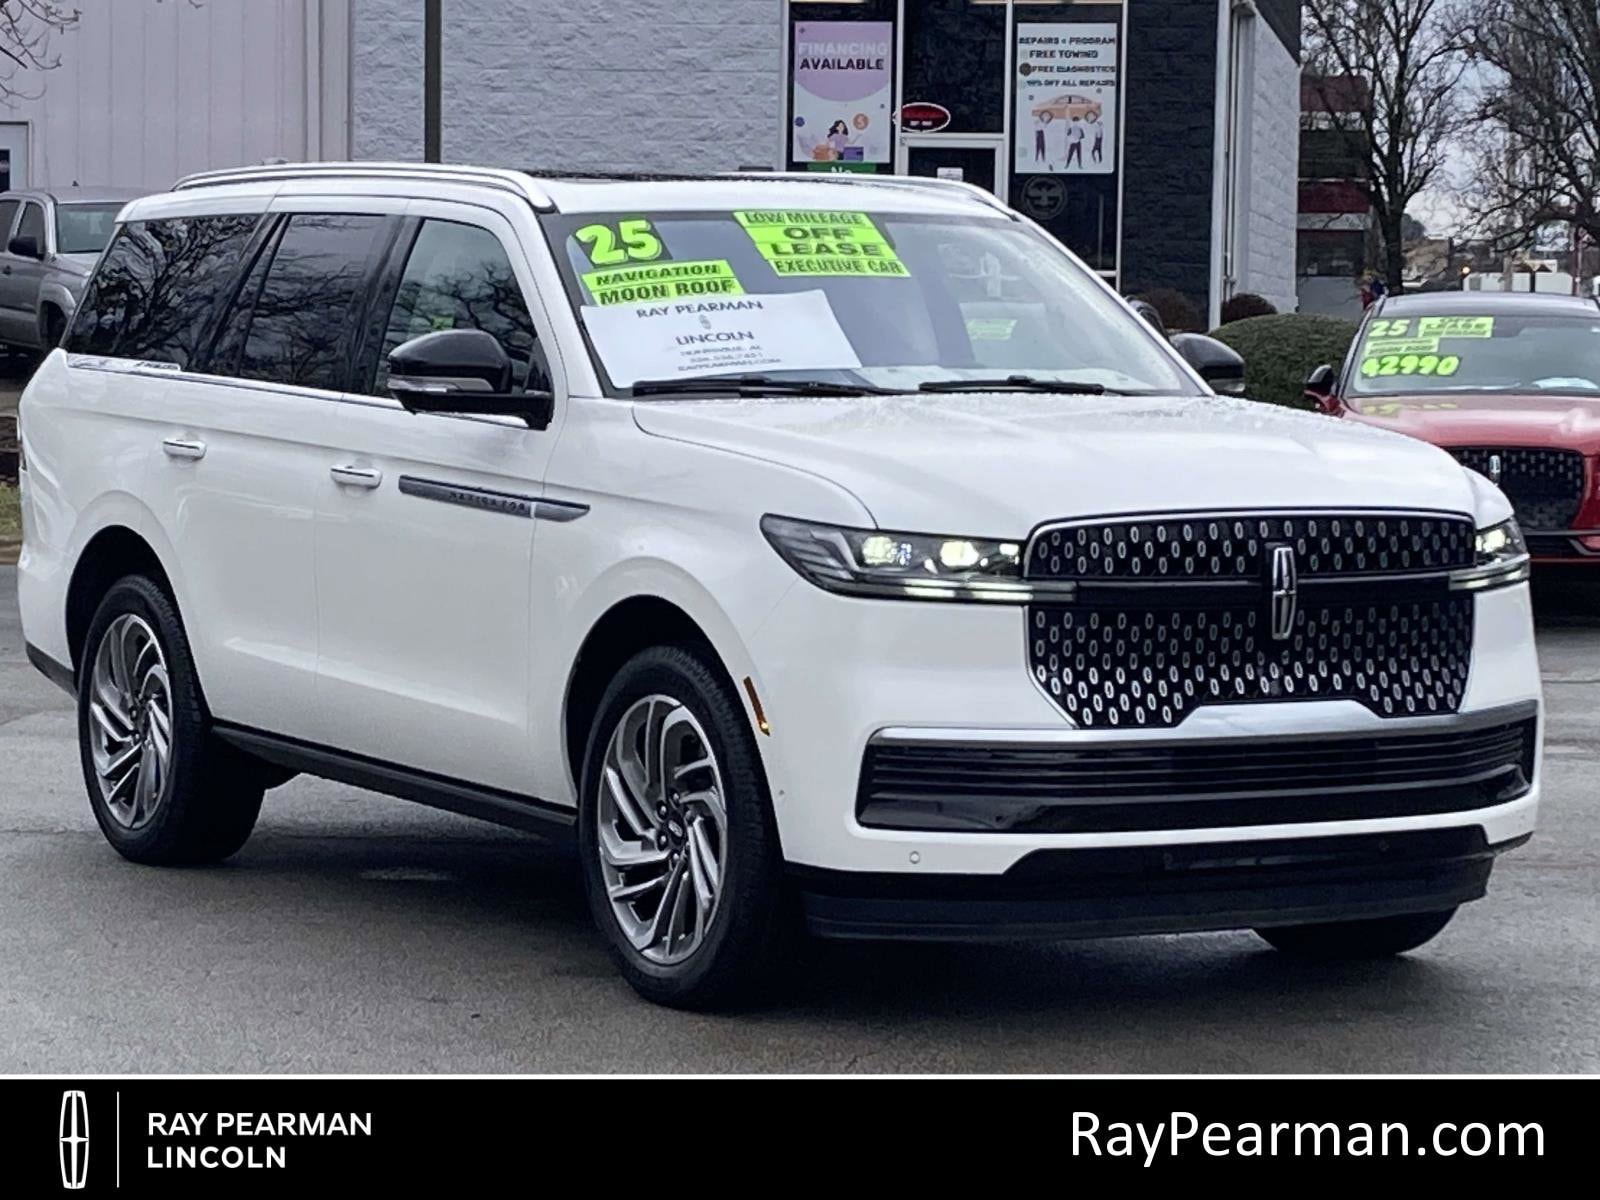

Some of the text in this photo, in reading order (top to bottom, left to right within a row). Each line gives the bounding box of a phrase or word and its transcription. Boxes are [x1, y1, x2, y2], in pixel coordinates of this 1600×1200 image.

[1019, 36, 1116, 45] REPAIRS PROGRAM
[799, 42, 888, 56] FINANCING
[1029, 49, 1099, 58] FREE TOWING
[800, 58, 884, 70] AVAILABLE
[1031, 65, 1055, 73] FREE
[744, 211, 865, 226] LOW MILEAGE
[783, 227, 854, 241] OFF
[575, 219, 662, 265] 25
[771, 243, 883, 257] LEASE
[775, 259, 904, 275] EXECUTIVE CAR
[596, 263, 722, 287] NAVIGATION
[599, 278, 736, 306] MOON ROOF
[636, 300, 764, 319] RAY PEARMAN
[1368, 319, 1411, 337] 25
[675, 330, 755, 347] LINCOLN
